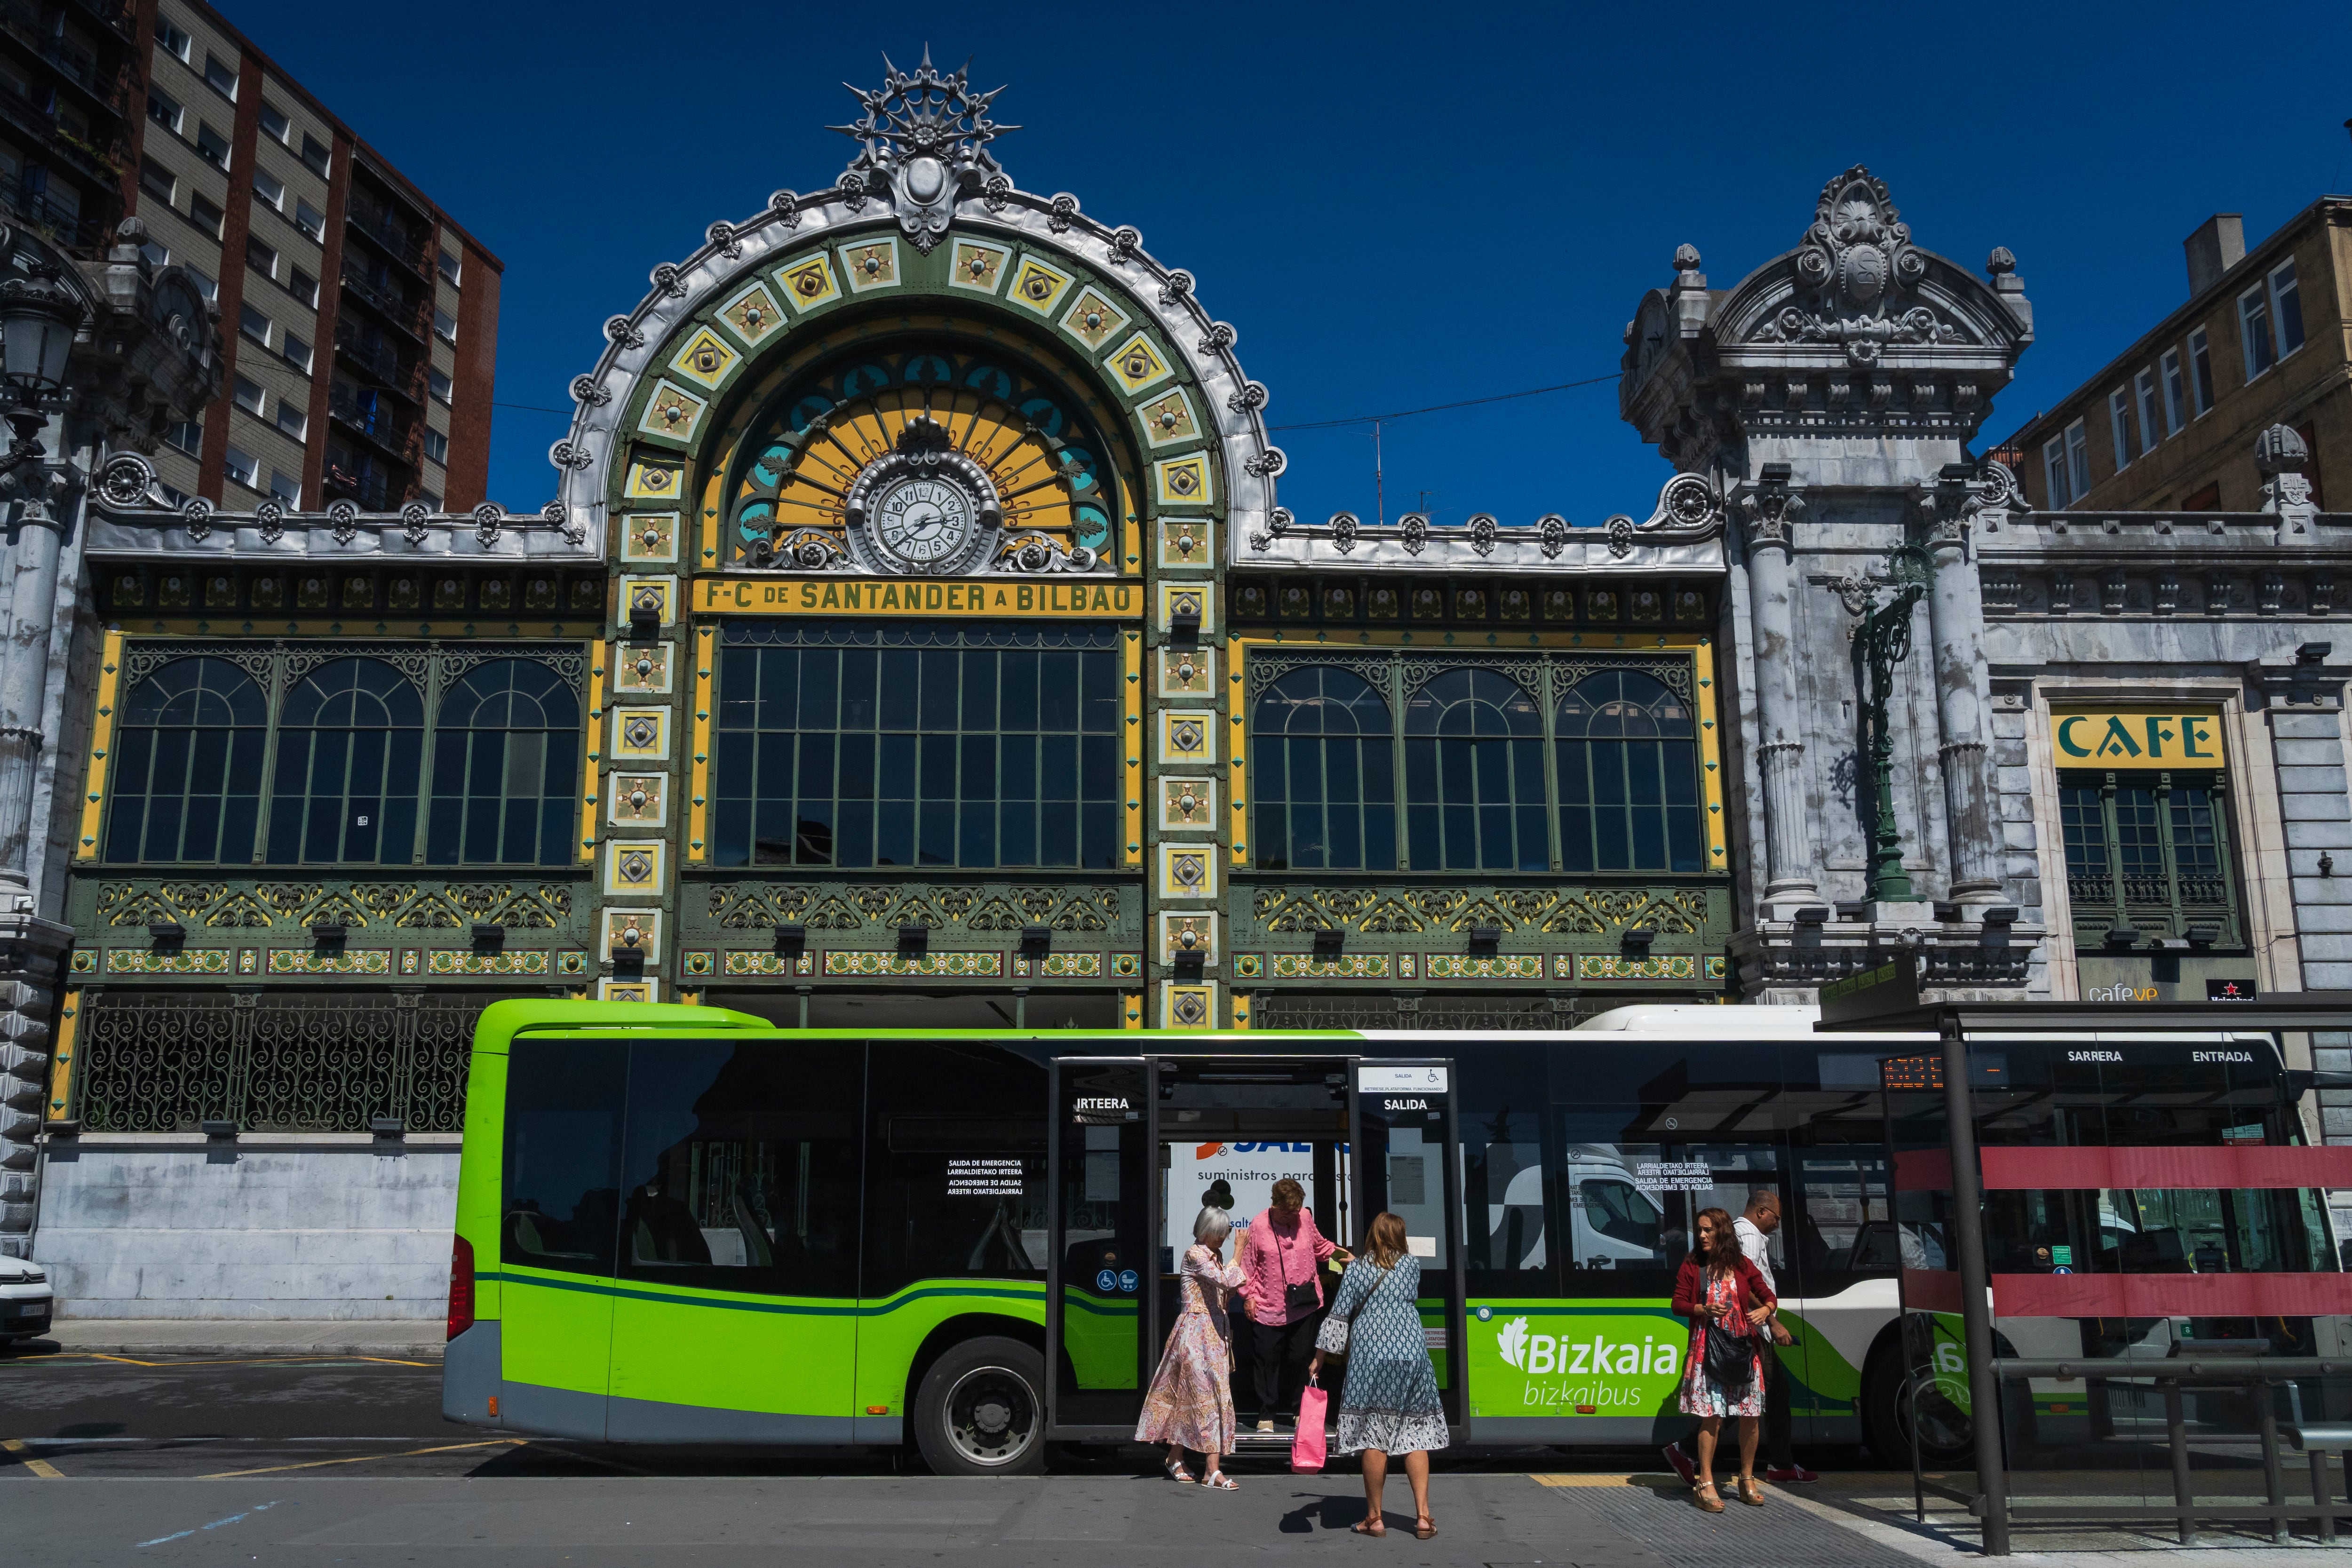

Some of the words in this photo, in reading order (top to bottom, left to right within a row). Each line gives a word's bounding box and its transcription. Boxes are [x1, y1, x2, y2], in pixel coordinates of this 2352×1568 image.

[904, 491, 913, 501] 11
[918, 487, 930, 498] 12
[937, 491, 941, 501] 1
[892, 501, 903, 512] 10
[948, 501, 955, 511] 2
[887, 516, 894, 525] 9
[952, 517, 959, 526] 3
[892, 531, 898, 541] 8
[946, 531, 954, 541] 4
[904, 541, 912, 551] 7
[919, 544, 926, 554] 6
[934, 541, 941, 551] 5
[764, 586, 788, 603] DE
[801, 582, 985, 611] SANTANDER
[994, 589, 1007, 606] A
[1017, 585, 1130, 611] BILBAO
[2058, 715, 2214, 758] CAFE
[1878, 966, 1895, 980] A3632
[2068, 1051, 2122, 1061] SARRERA
[2193, 1051, 2253, 1062] ENTRADA
[1077, 1098, 1129, 1109] IRTEERA
[1384, 1099, 1428, 1110] SALIDA
[1198, 1169, 1277, 1181] suministros
[1528, 1335, 1677, 1374] Bizkaia
[1524, 1380, 1641, 1406] bizkaibus
